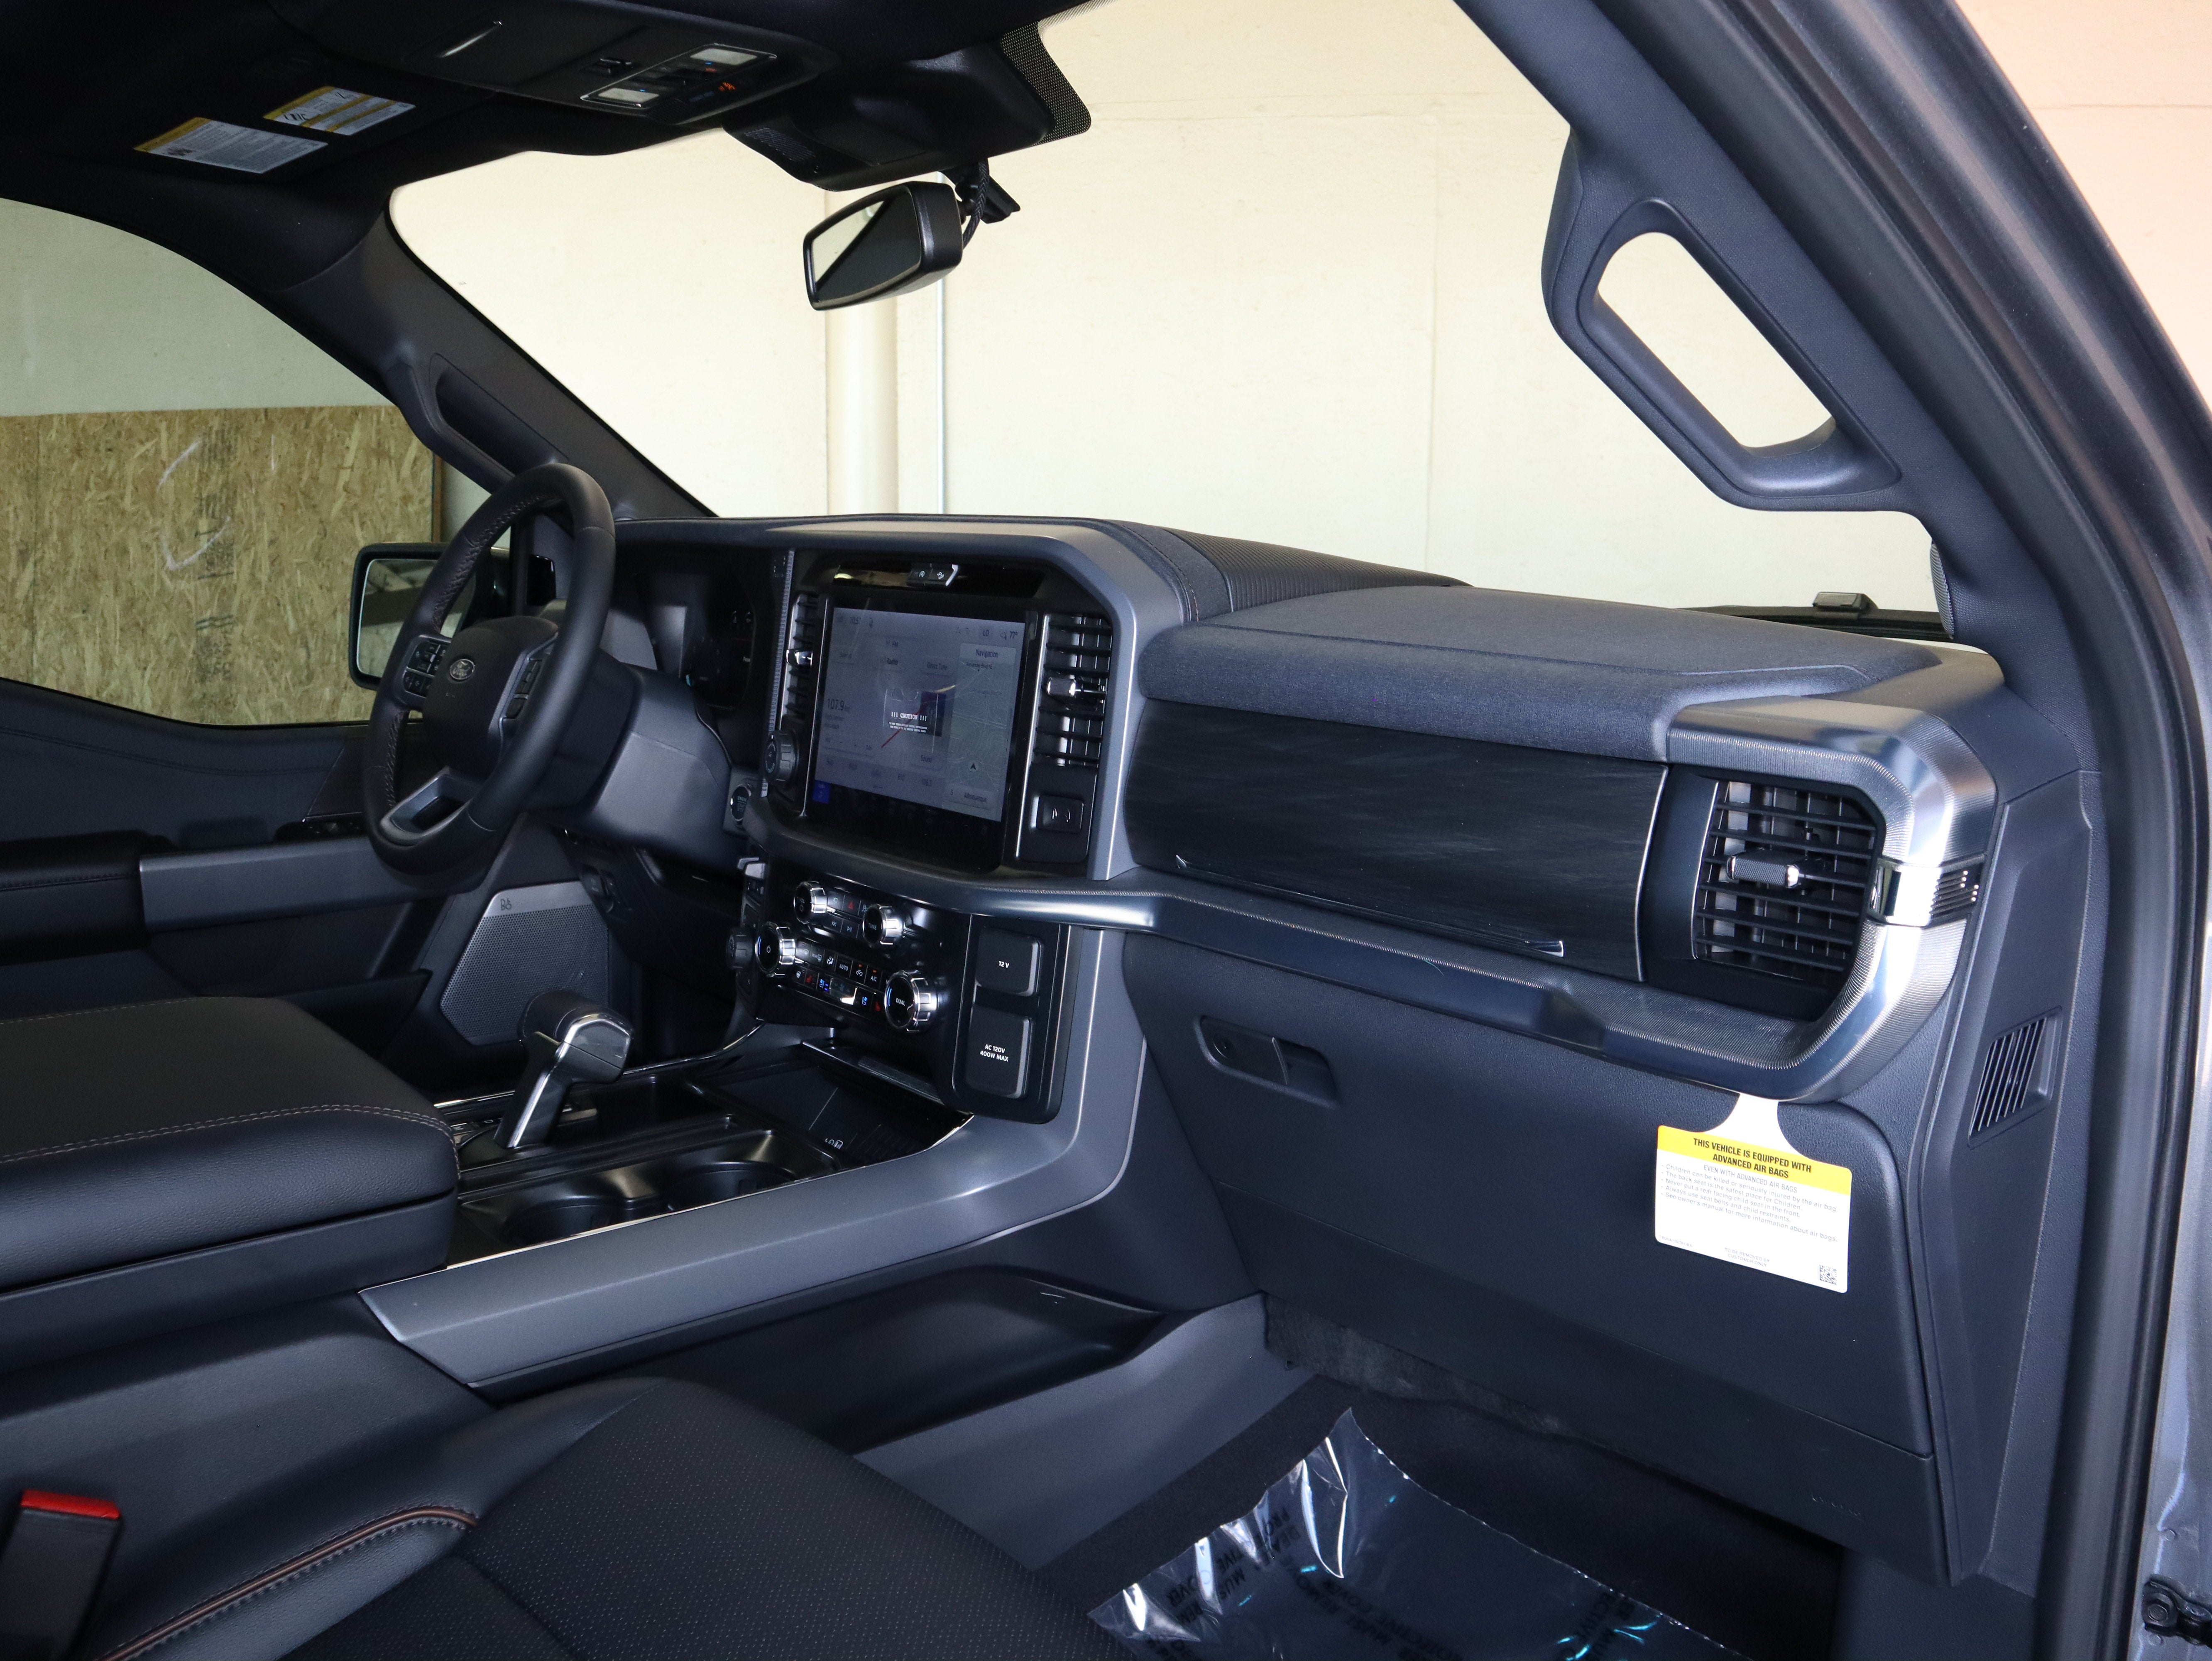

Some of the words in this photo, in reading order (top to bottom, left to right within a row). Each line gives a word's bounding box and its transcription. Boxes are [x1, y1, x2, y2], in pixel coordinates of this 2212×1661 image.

[976, 649, 998, 658] Navigation
[827, 698, 844, 711] 107.9
[896, 998, 905, 1007] DUAL
[980, 1050, 996, 1059] 400W
[996, 1053, 1009, 1062] MAX
[993, 1045, 1006, 1053] 120V
[1693, 1138, 1710, 1149] THIS
[1711, 1142, 1741, 1156] VEHICLE
[1743, 1149, 1750, 1158] IS
[1752, 1151, 1789, 1167] EQUIPPED
[1791, 1161, 1812, 1173] WITH
[1713, 1154, 1752, 1169] ADVANCED
[1754, 1164, 1767, 1173] AIR
[1769, 1166, 1789, 1178] BAGS
[1666, 1164, 1691, 1174] Children
[1739, 1183, 1767, 1195] seriously
[1769, 1190, 1790, 1200] injured
[1824, 1204, 1838, 1213] bag.
[1704, 1164, 1718, 1173] EVEN
[1720, 1169, 1735, 1178] WITH
[1737, 1173, 1767, 1186] ADVANCED
[1781, 1183, 1797, 1193] BAGS
[1666, 1178, 1683, 1187] Never
[1713, 1191, 1732, 1200] facing
[1784, 1209, 1801, 1218] front.
[1666, 1186, 1686, 1195] Always
[1714, 1198, 1729, 1206] belts
[1760, 1209, 1791, 1222] restraints.
[1725, 1187, 1744, 1196] safest
[1774, 1198, 1802, 1210] Children.
[1678, 1196, 1701, 1206] owner's
[1702, 1203, 1724, 1212] manual
[1753, 1215, 1788, 1229] information
[1790, 1225, 1808, 1235] about
[1810, 1229, 1818, 1237] air
[1820, 1232, 1838, 1242] bags.
[1728, 1253, 1753, 1263] CUSTOMER
[1740, 1252, 1762, 1261] REMOVED
